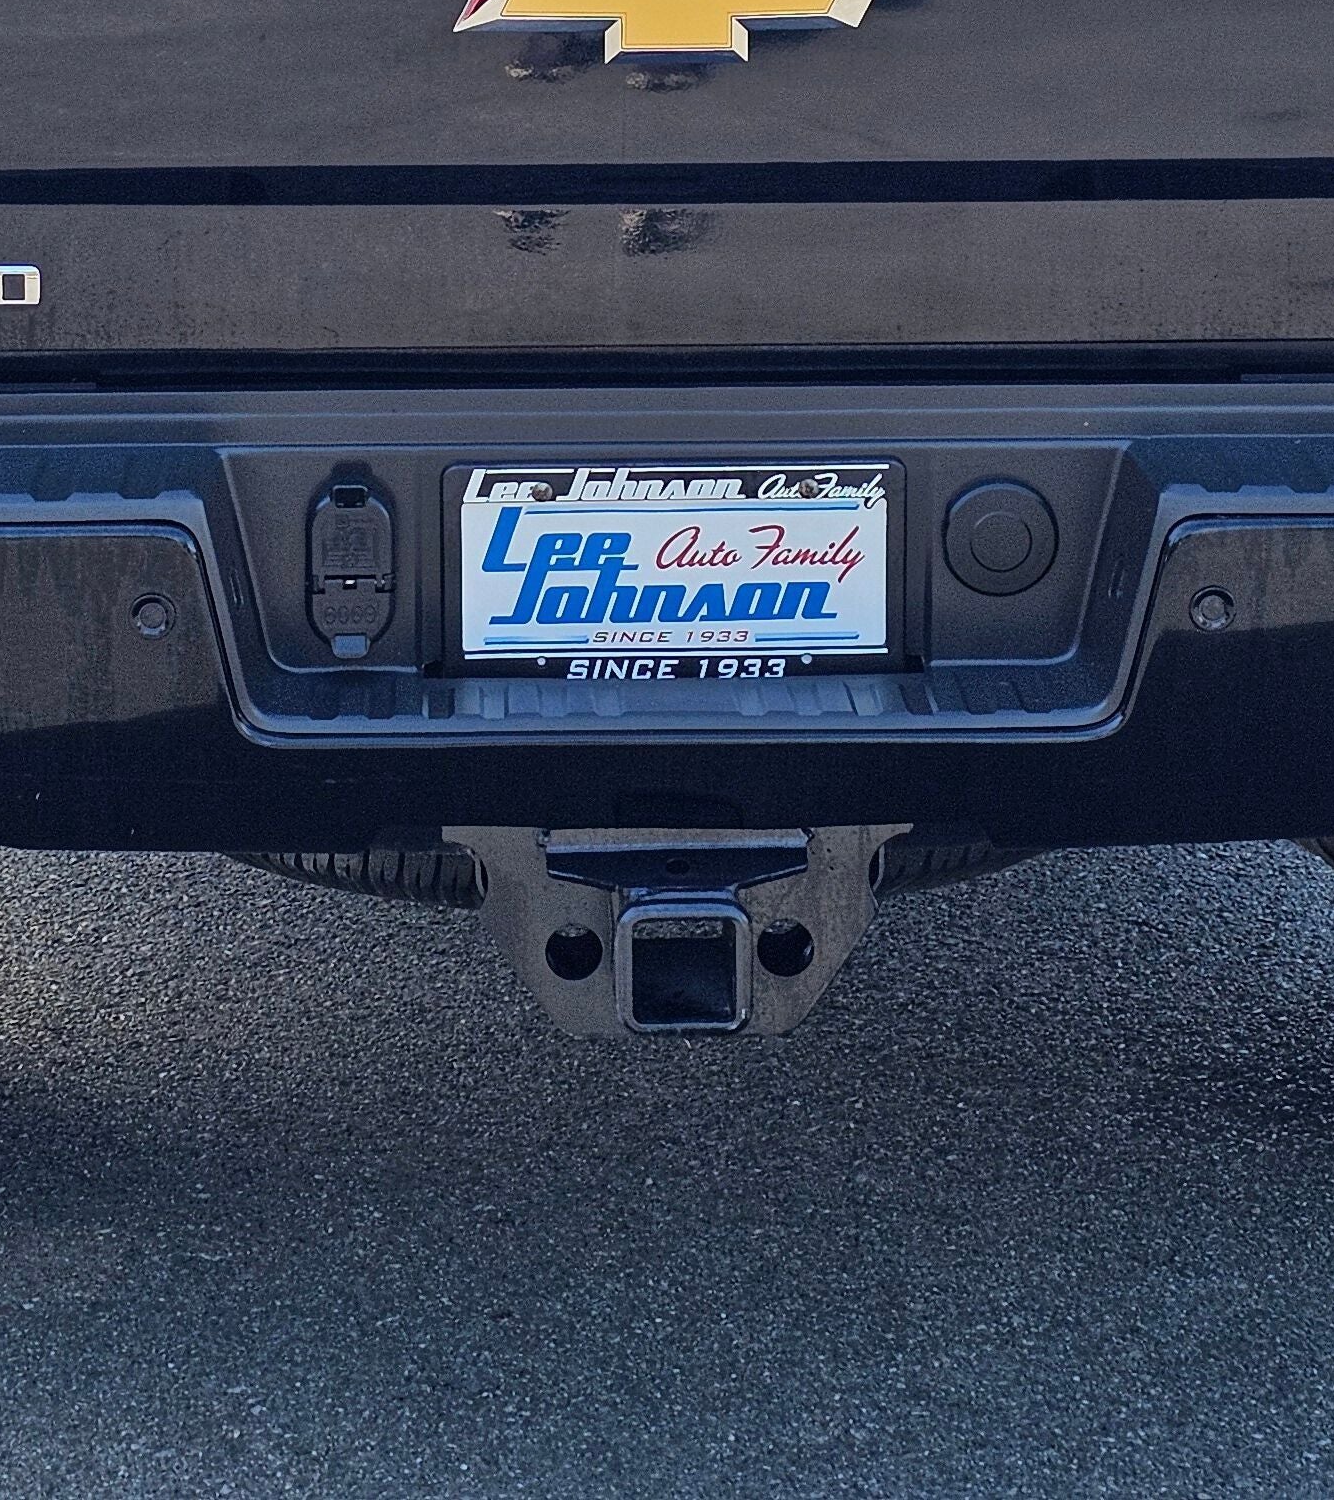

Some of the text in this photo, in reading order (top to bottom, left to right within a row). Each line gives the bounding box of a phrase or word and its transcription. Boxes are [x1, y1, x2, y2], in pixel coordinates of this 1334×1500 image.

[555, 467, 747, 502] Johnson
[813, 472, 886, 509] Family
[481, 506, 639, 572] Lee
[655, 524, 866, 584] Auto Family
[489, 568, 837, 625] Johnson
[592, 630, 749, 644] SINCE 1933
[566, 658, 787, 680] SINCE 1933
